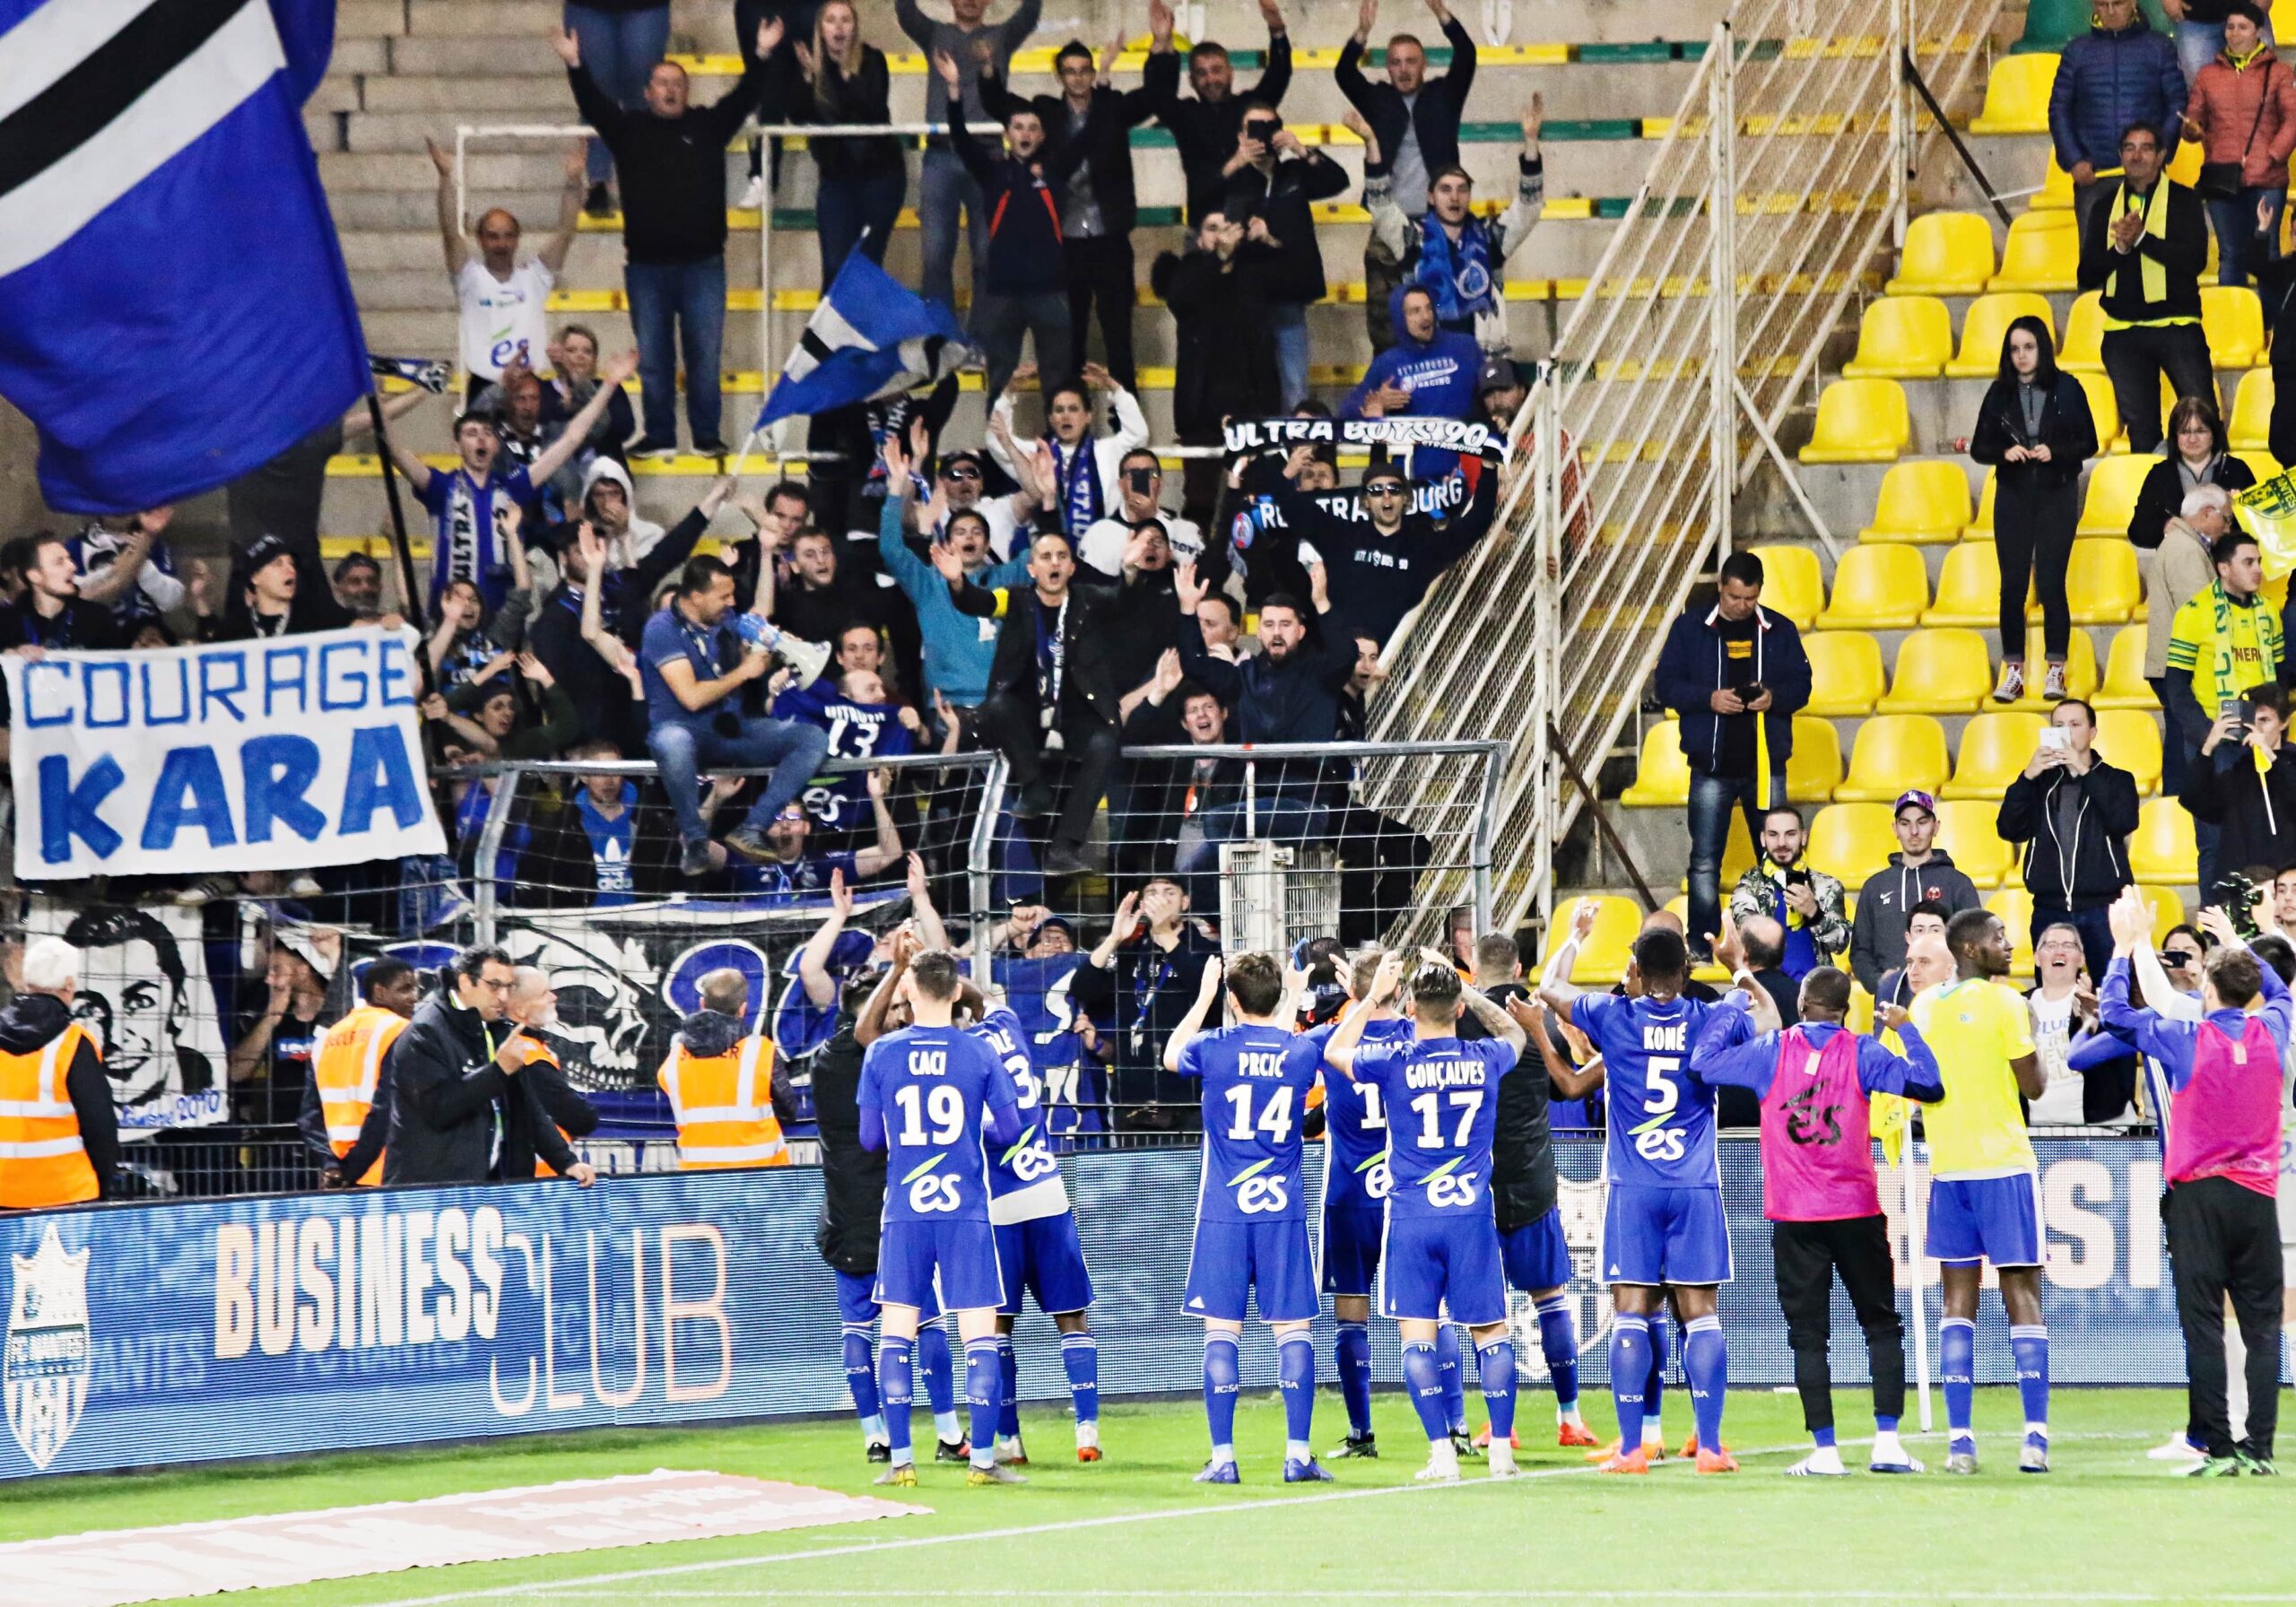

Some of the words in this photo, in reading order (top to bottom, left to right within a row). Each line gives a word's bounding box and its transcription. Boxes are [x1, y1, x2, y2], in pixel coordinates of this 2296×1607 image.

[1225, 421, 1334, 452] ULTRA
[1344, 421, 1437, 442] BOYS
[22, 638, 416, 728] COURAGE
[827, 719, 880, 759] 13
[39, 723, 424, 864] KARA
[1643, 1021, 1688, 1052] KONÉ
[908, 1050, 947, 1076] CACI
[1239, 1049, 1288, 1078] PRCIĆ
[1405, 1060, 1485, 1091] GONÇALVES
[1352, 1082, 1387, 1129] 1
[1643, 1056, 1681, 1115] 5
[894, 1084, 965, 1146] 19
[1225, 1082, 1294, 1144] 14
[1411, 1091, 1484, 1150] 17
[1364, 1166, 1394, 1199] e
[213, 1205, 504, 1359] BUSINESS
[489, 1223, 733, 1416] CLUB
[1279, 1380, 1300, 1390] CSA
